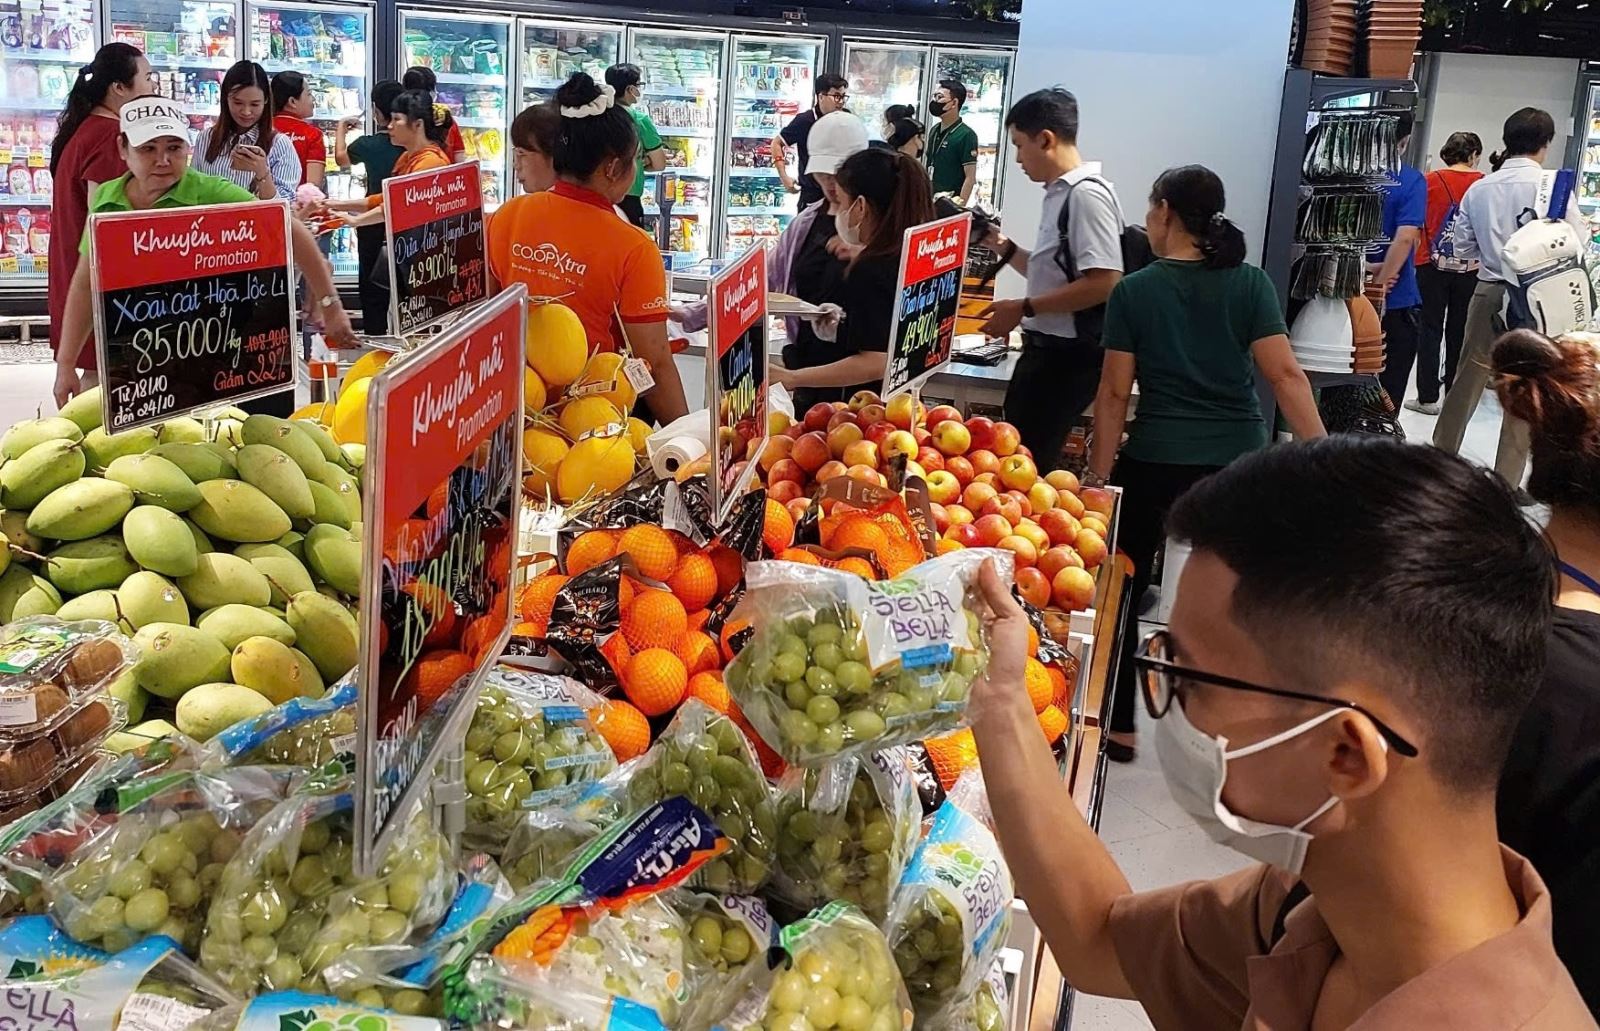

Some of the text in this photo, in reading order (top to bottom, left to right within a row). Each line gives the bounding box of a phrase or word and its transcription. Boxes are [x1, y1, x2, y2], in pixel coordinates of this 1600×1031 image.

[405, 174, 466, 206] Khuyến mãi
[435, 197, 468, 214] Promotion
[133, 216, 257, 256] Khuyến mãi
[194, 248, 258, 270] Promotion
[171, 281, 201, 315] cát
[213, 346, 288, 392] Giảm 22%
[412, 332, 505, 447] Khuyến mãi
[113, 394, 175, 427] đến 24/10
[457, 390, 503, 451] Promotion
[890, 614, 954, 643] BELLA
[669, 817, 702, 856] Air
